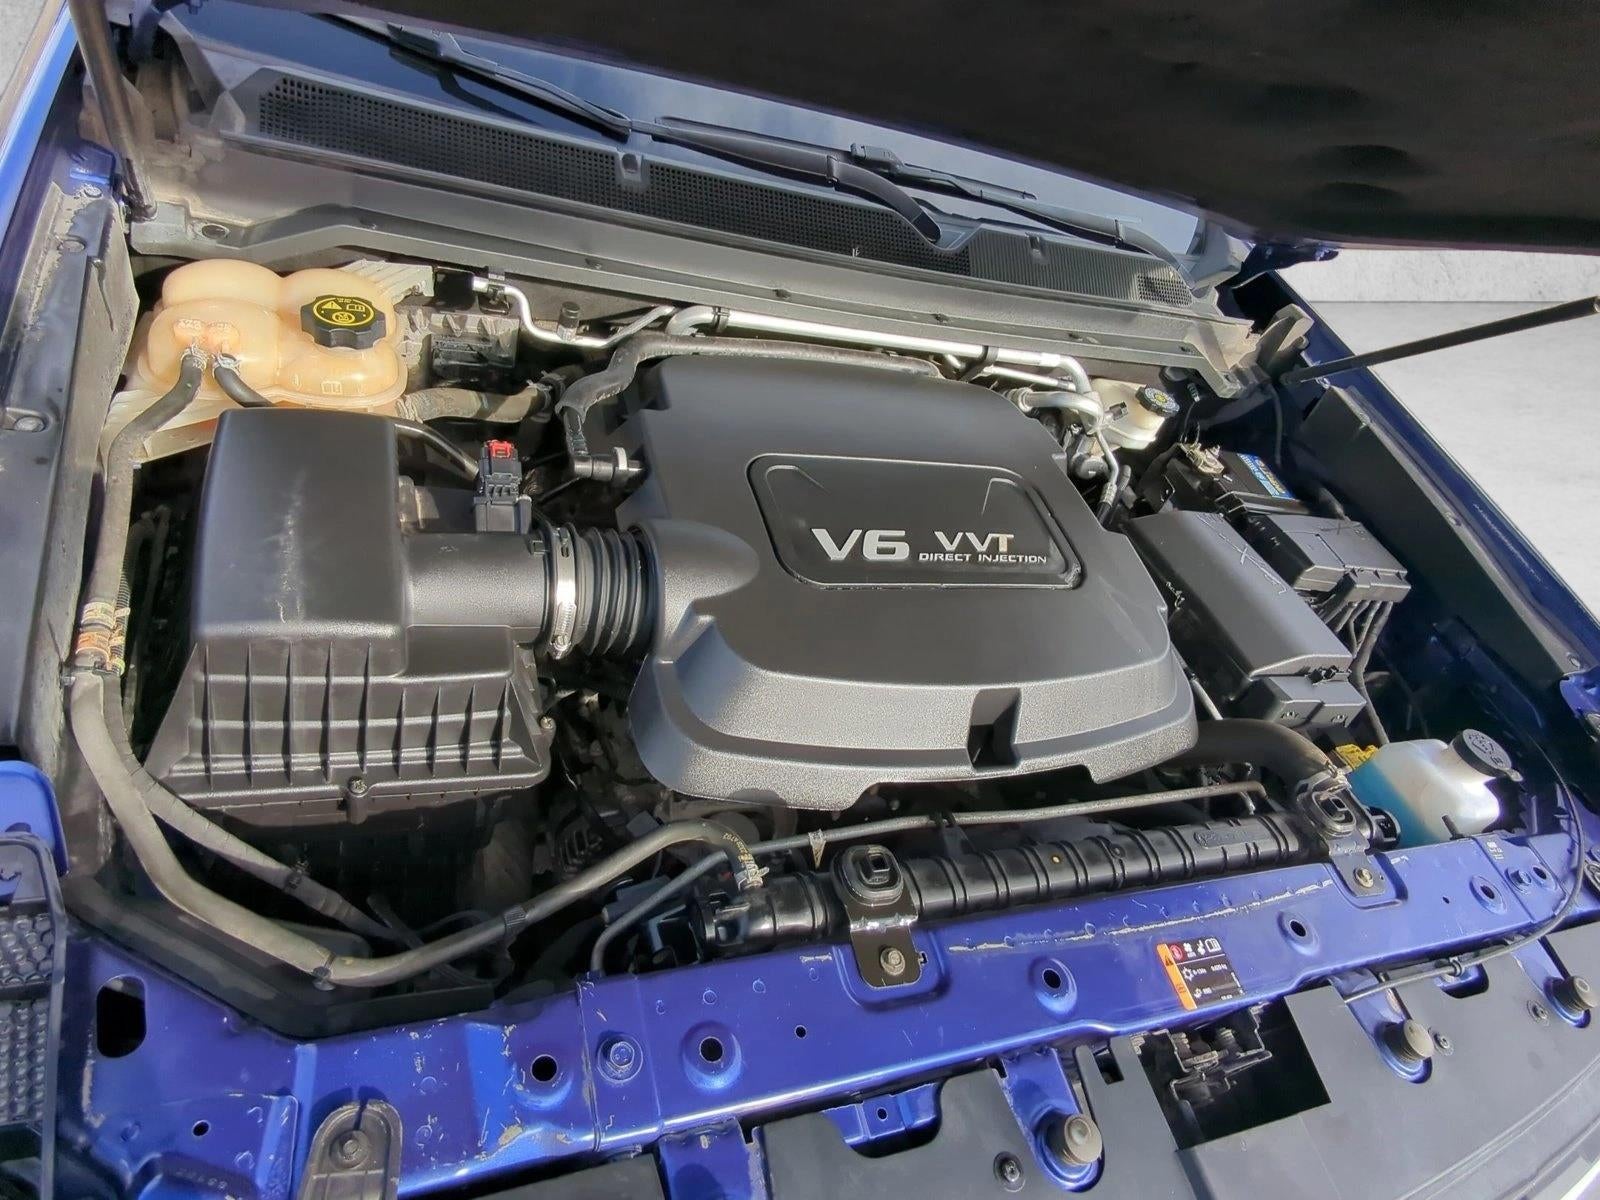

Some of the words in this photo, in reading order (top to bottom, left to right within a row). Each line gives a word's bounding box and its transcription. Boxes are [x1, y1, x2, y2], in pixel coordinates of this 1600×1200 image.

[811, 528, 910, 561] V6
[934, 531, 1015, 552] VVT
[918, 552, 971, 562] DIRECT
[978, 553, 1047, 564] INJECTION
